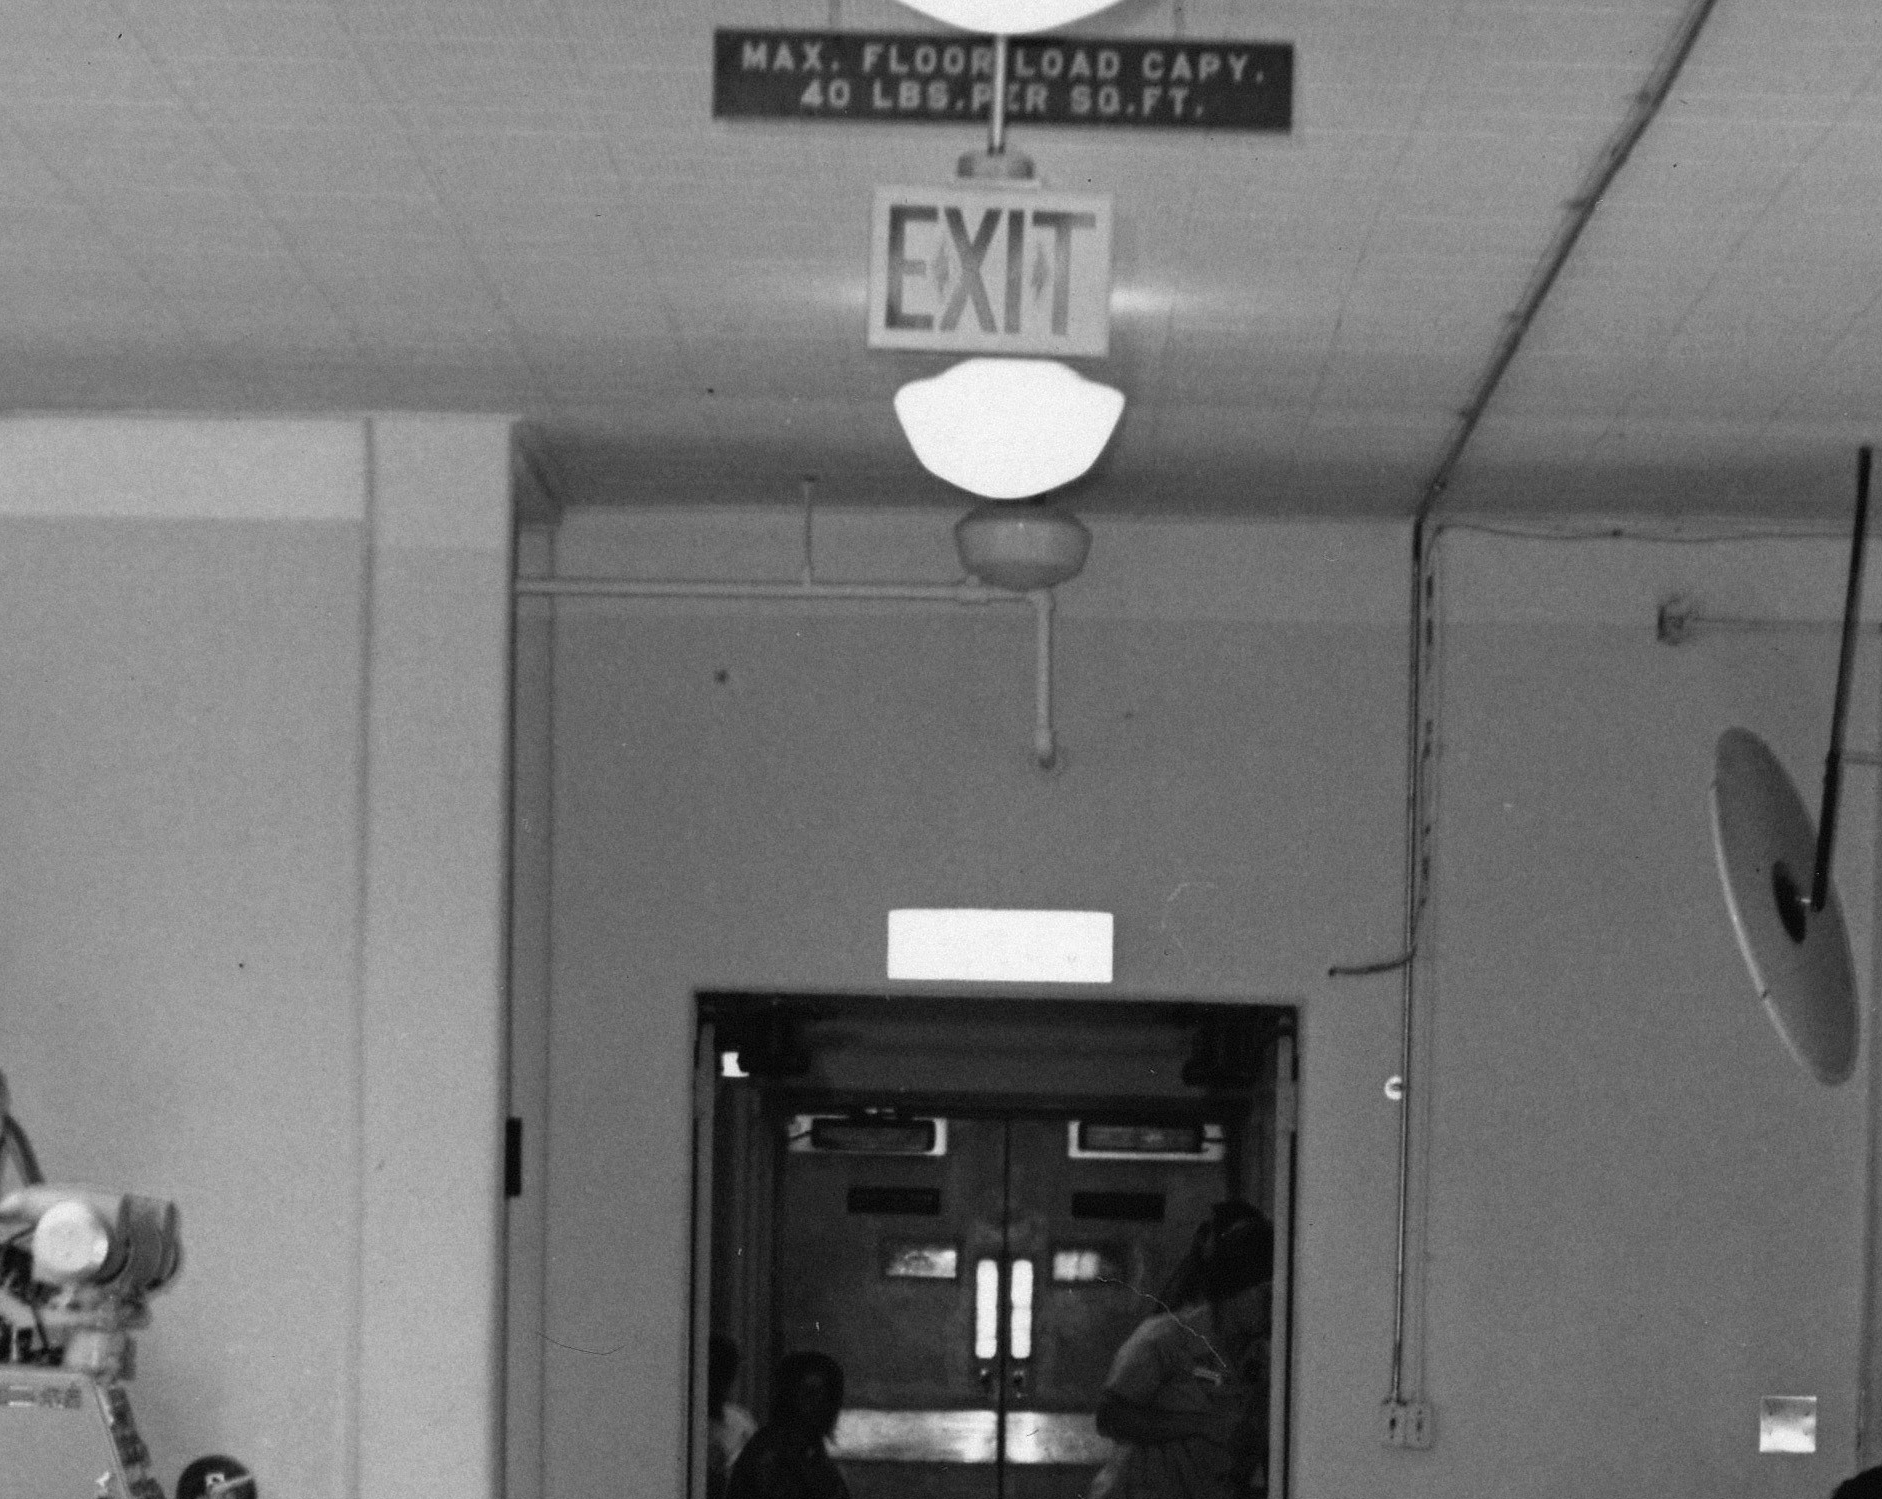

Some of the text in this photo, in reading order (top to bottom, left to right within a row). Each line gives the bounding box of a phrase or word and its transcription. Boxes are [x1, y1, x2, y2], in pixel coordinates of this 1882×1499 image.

[741, 41, 1264, 84] MAX. FLOOR LOAD CAPY.
[800, 78, 851, 109] 40
[885, 204, 1096, 336] EXIT
